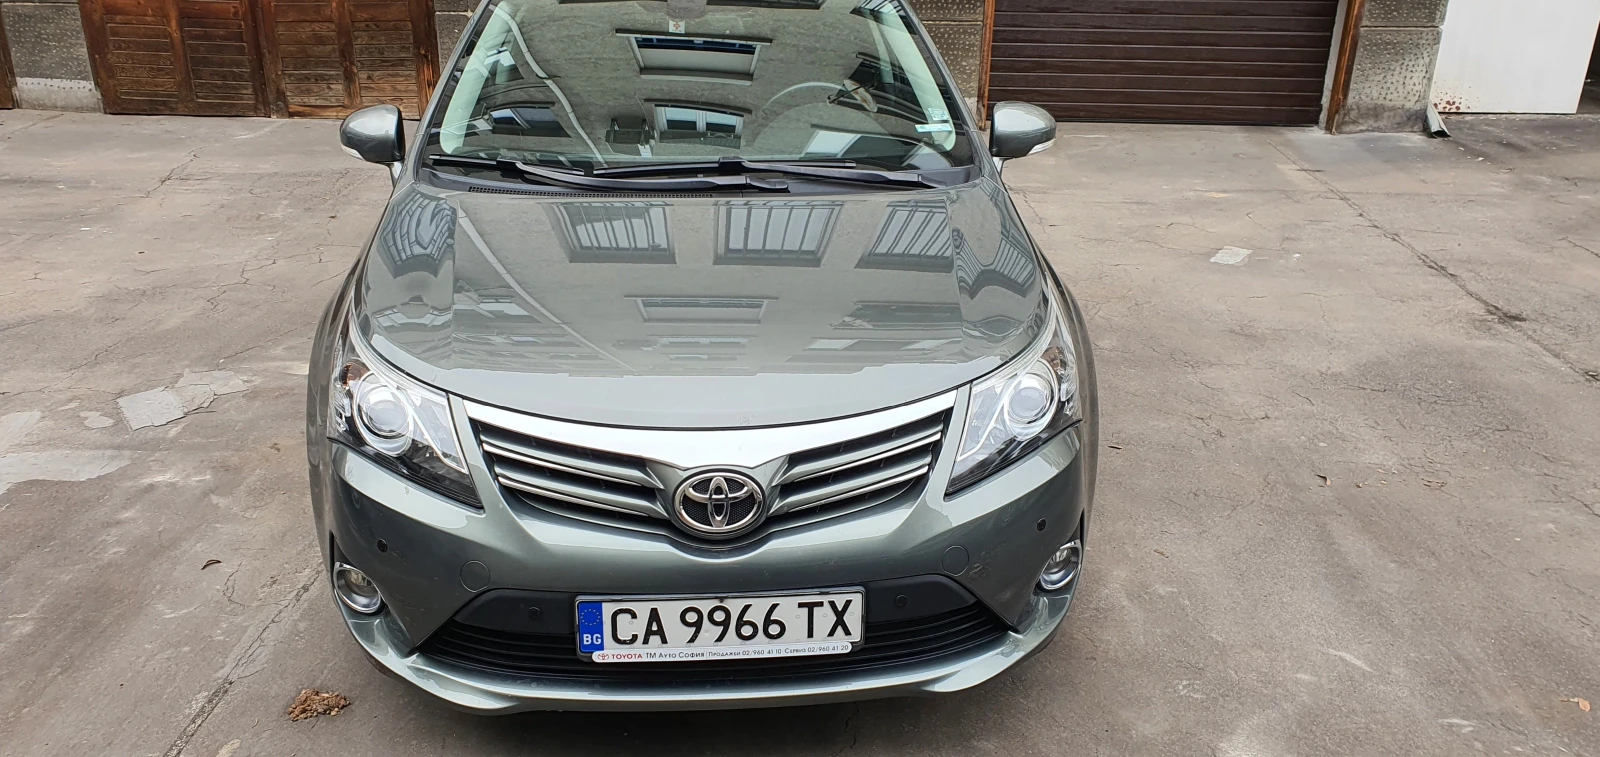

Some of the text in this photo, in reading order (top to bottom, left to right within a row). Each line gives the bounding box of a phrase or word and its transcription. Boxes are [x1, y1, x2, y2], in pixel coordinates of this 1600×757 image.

[611, 600, 853, 645] CA 9966 TX
[584, 634, 601, 645] BG
